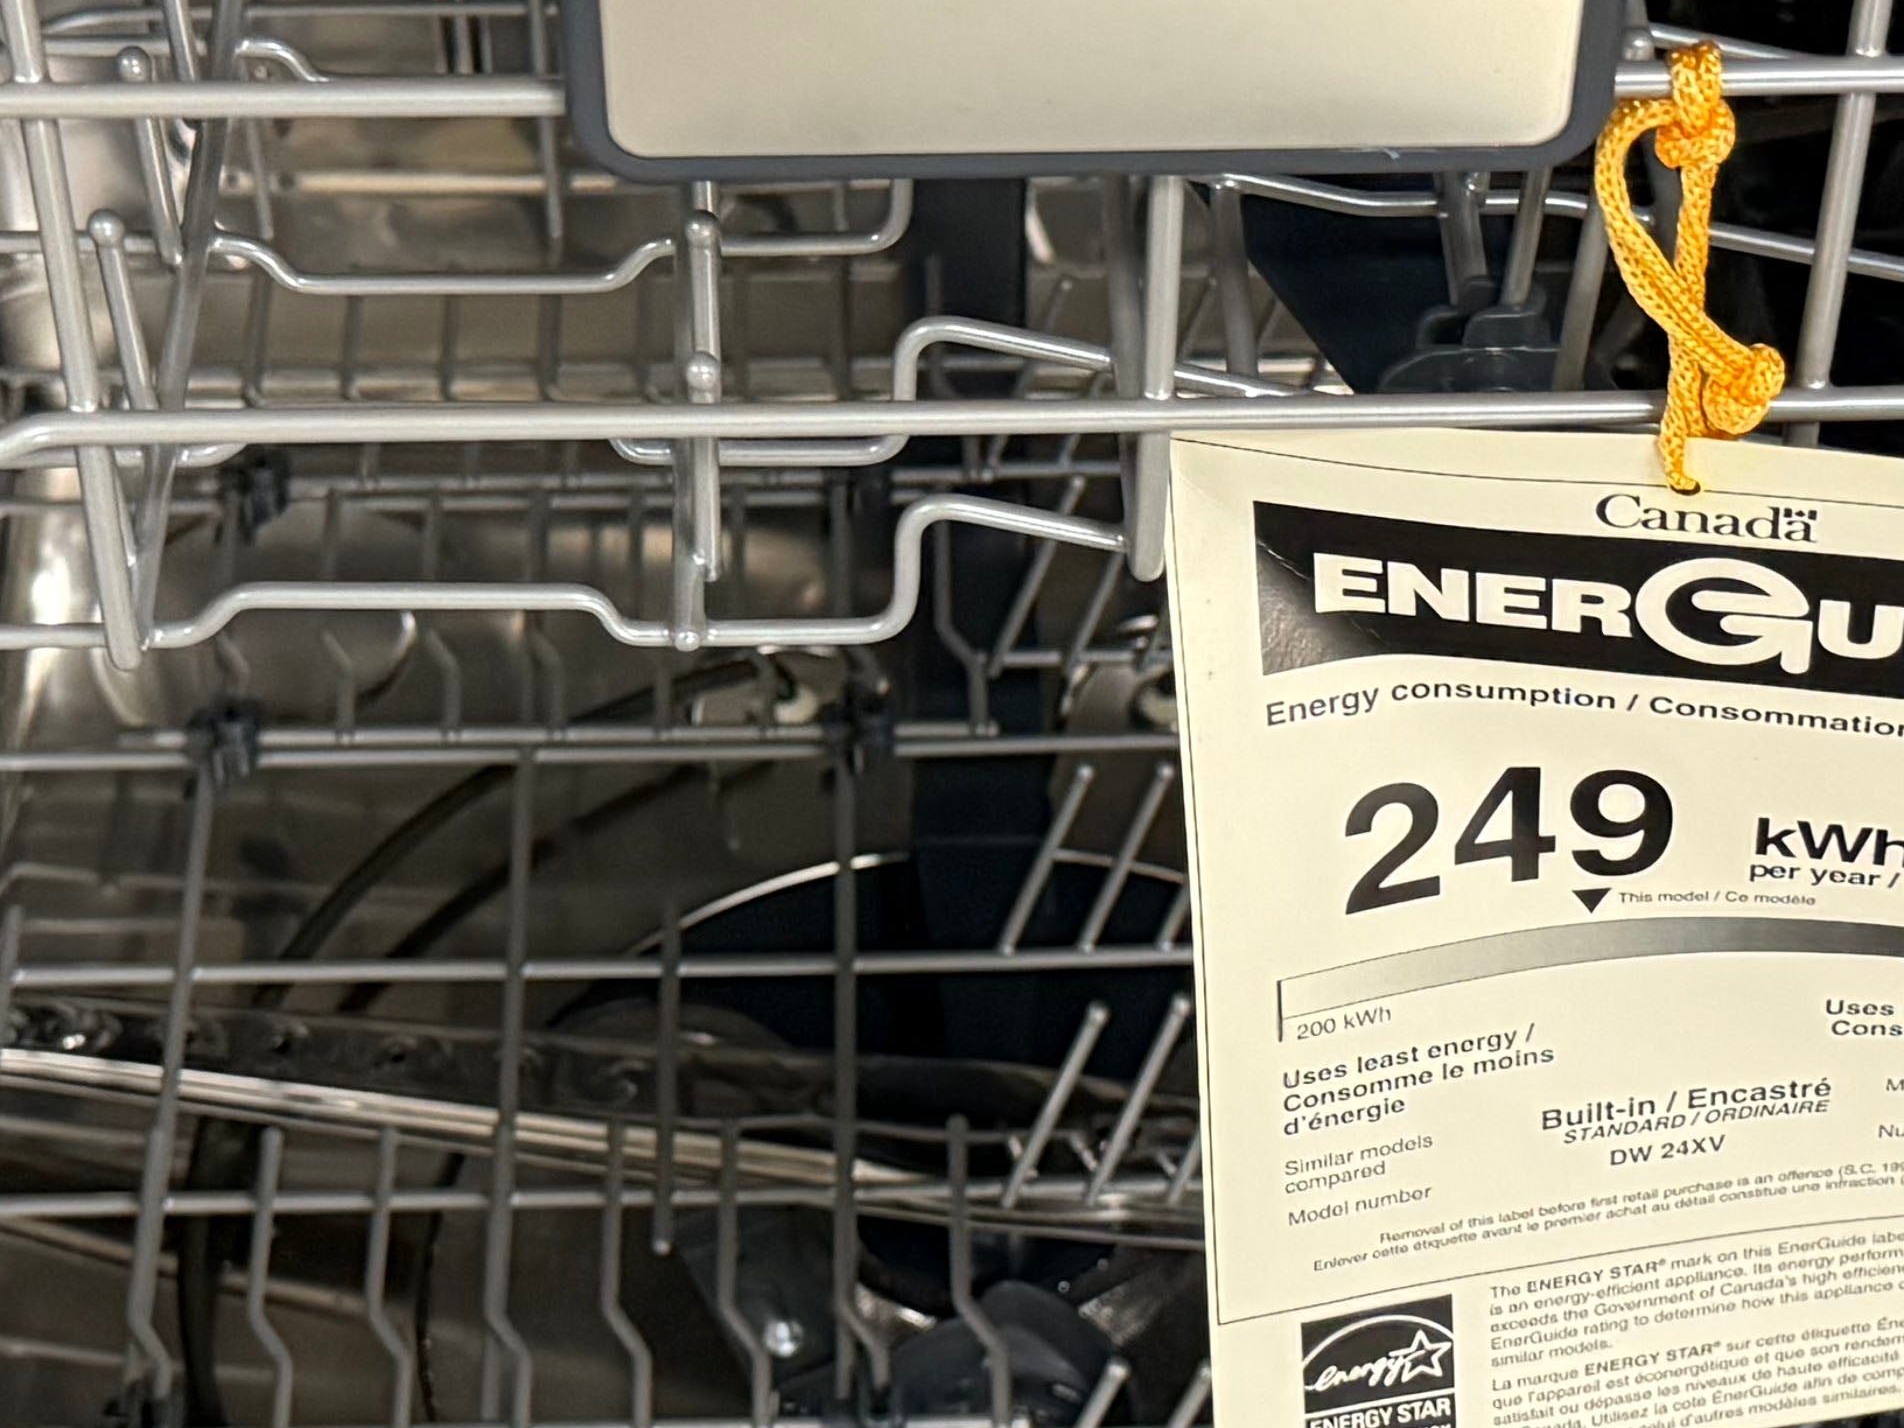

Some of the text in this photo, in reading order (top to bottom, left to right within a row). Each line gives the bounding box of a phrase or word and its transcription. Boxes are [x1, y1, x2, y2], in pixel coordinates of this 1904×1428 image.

[1596, 493, 1817, 543] Canada
[1266, 687, 1379, 726] Energy
[1391, 683, 1615, 710] consumption
[1626, 693, 1639, 711] /
[1344, 766, 1674, 916] 249
[1749, 863, 1801, 882] per
[1810, 868, 1881, 886] year
[1887, 872, 1900, 889] /
[1619, 891, 1653, 903] This
[1658, 891, 1709, 902] model
[1724, 891, 1749, 903] Ce
[1754, 894, 1816, 905] modèle
[1297, 1007, 1391, 1040] 200 kWh
[1826, 999, 1894, 1017] Uses
[1283, 1022, 1535, 1089] Uses least energy /
[1283, 1048, 1554, 1112] Consomme le moins
[1284, 1097, 1405, 1136] d'énergie
[1542, 1077, 1831, 1131] Built-in / Encastré
[1564, 1100, 1831, 1144] STANDARD / ORDINAIRE
[1285, 1135, 1433, 1176] Similar models
[1610, 1134, 1725, 1166] DW 24XV
[1285, 1160, 1385, 1194] compared
[1288, 1187, 1432, 1226] Model number
[1397, 1397, 1452, 1423] STAR
